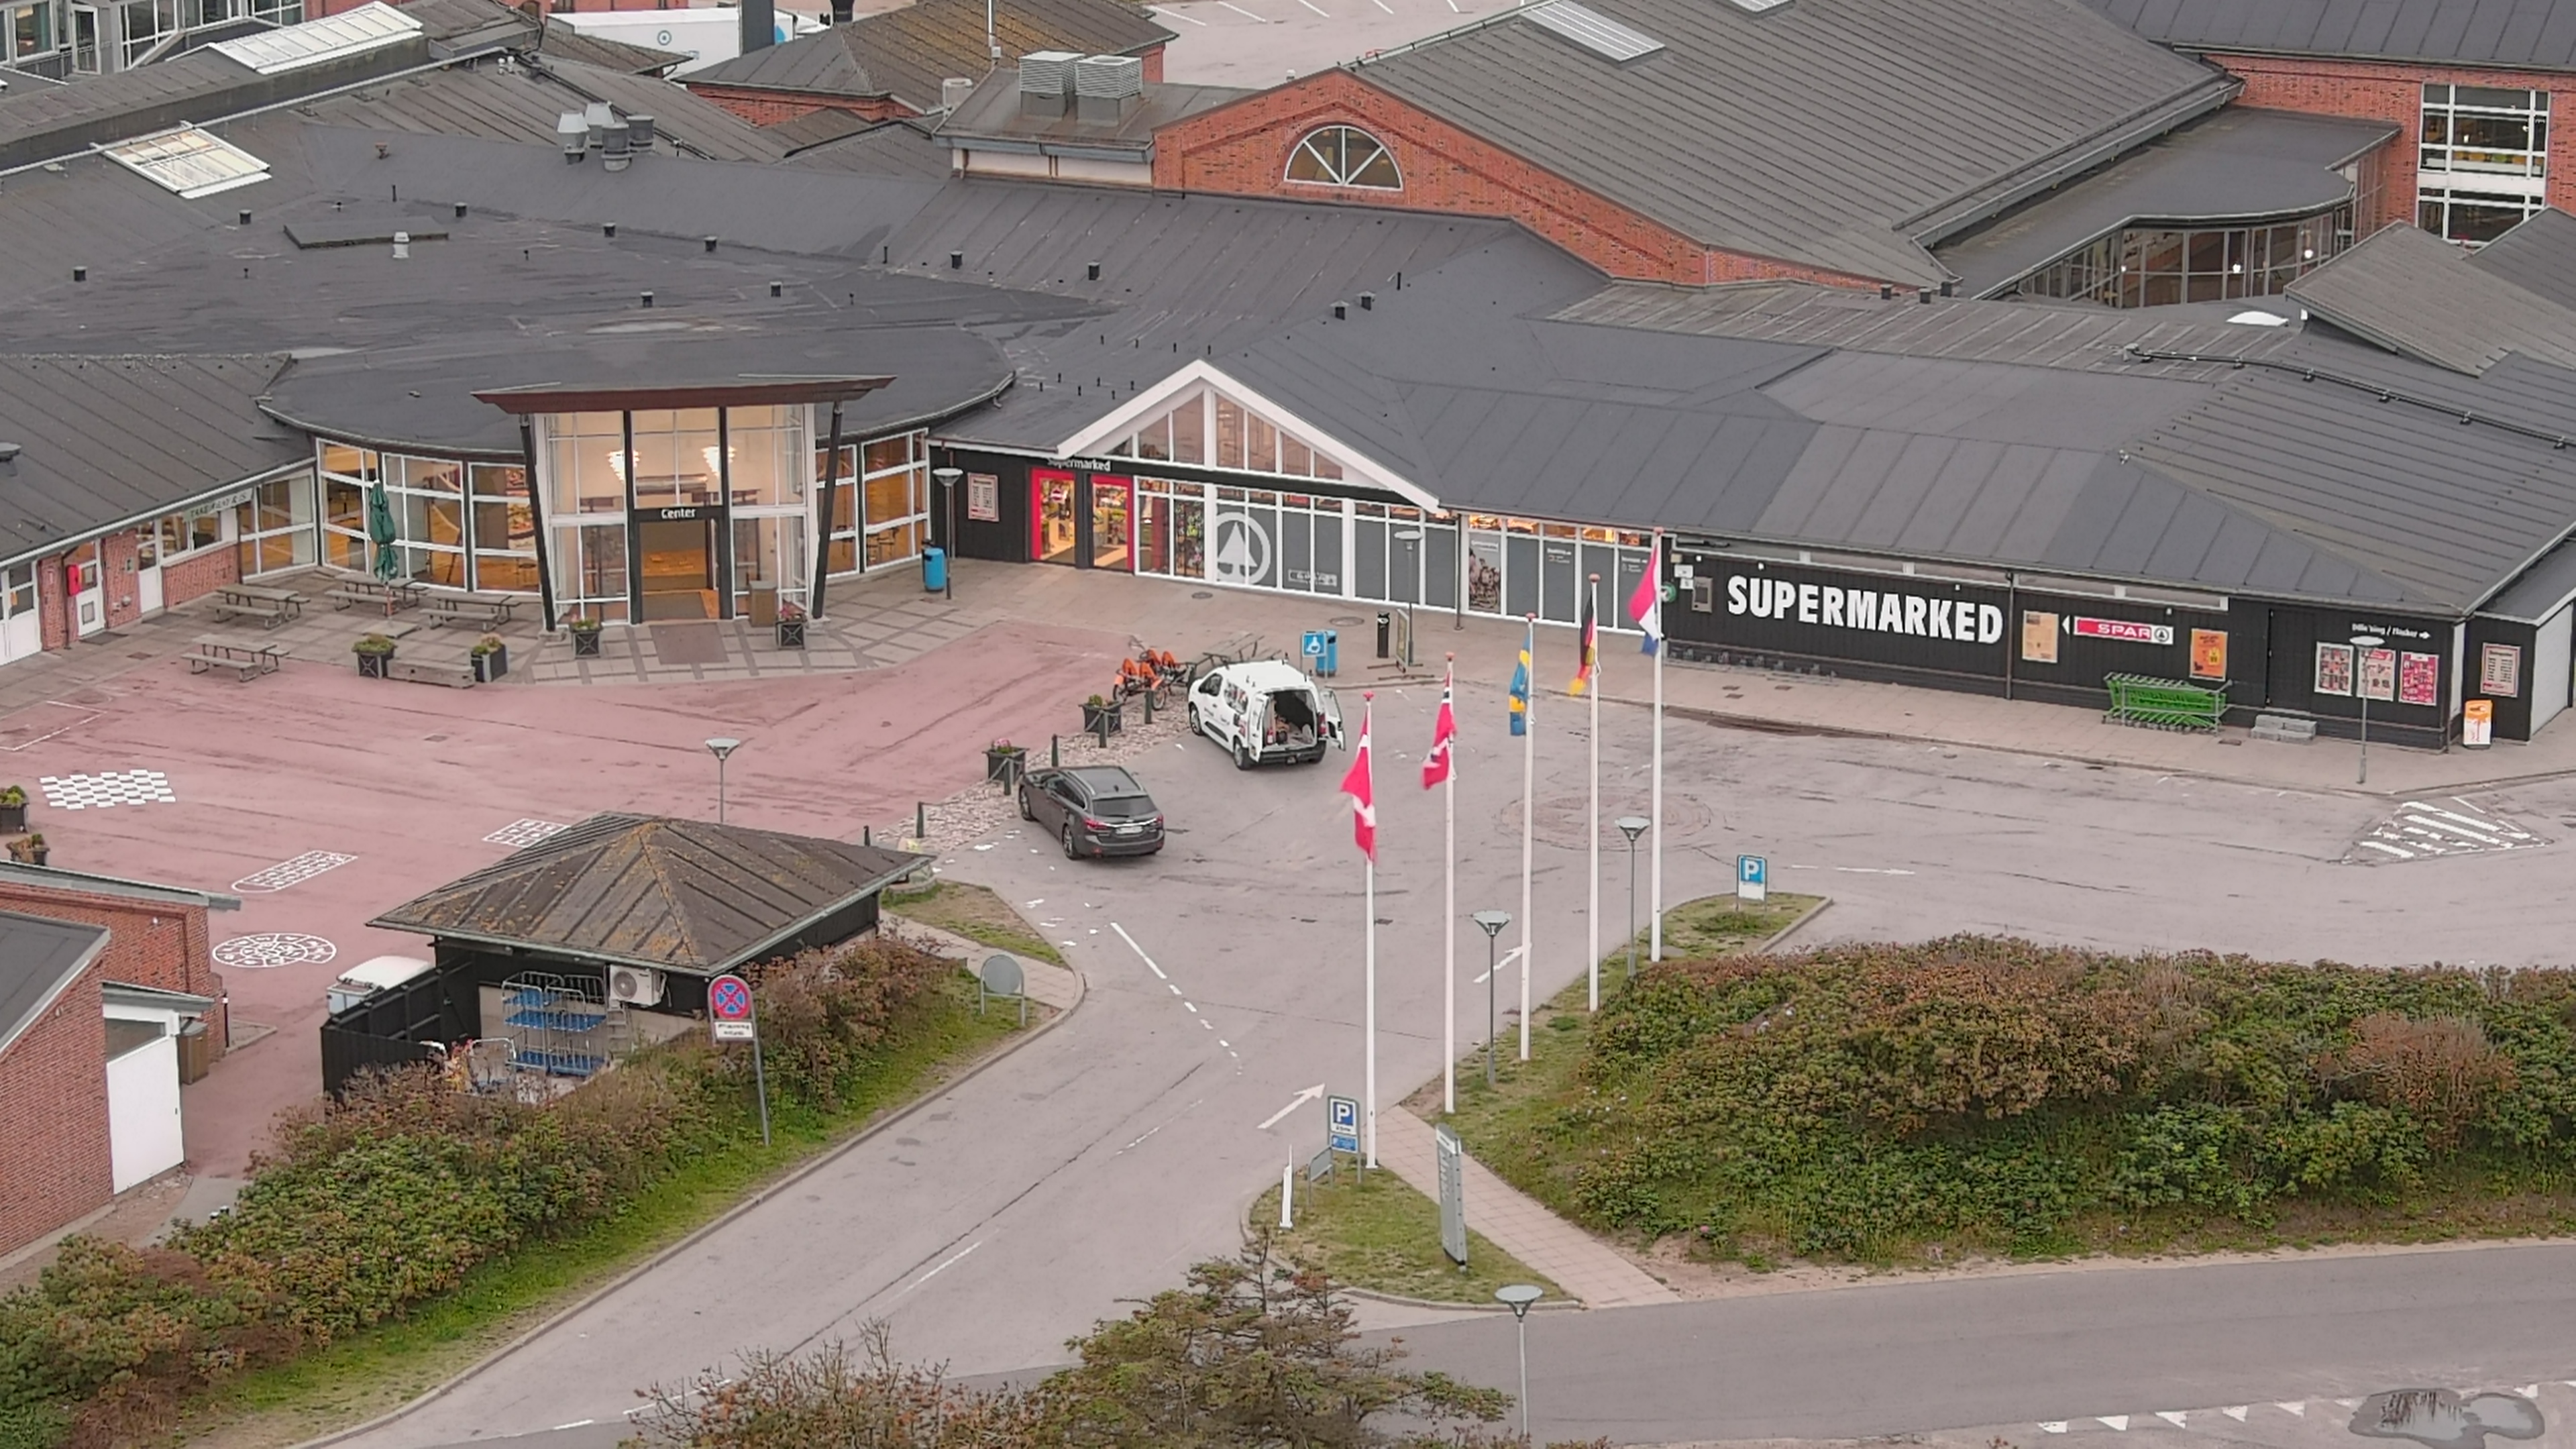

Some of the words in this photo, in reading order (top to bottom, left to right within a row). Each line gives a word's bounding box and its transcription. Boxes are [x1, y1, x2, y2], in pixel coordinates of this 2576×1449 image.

[661, 508, 696, 519] Center
[1727, 575, 2003, 644] SUPERMARKED
[2097, 623, 2151, 640] SPAR
[1745, 860, 1759, 880] P
[1336, 1104, 1350, 1122] P
